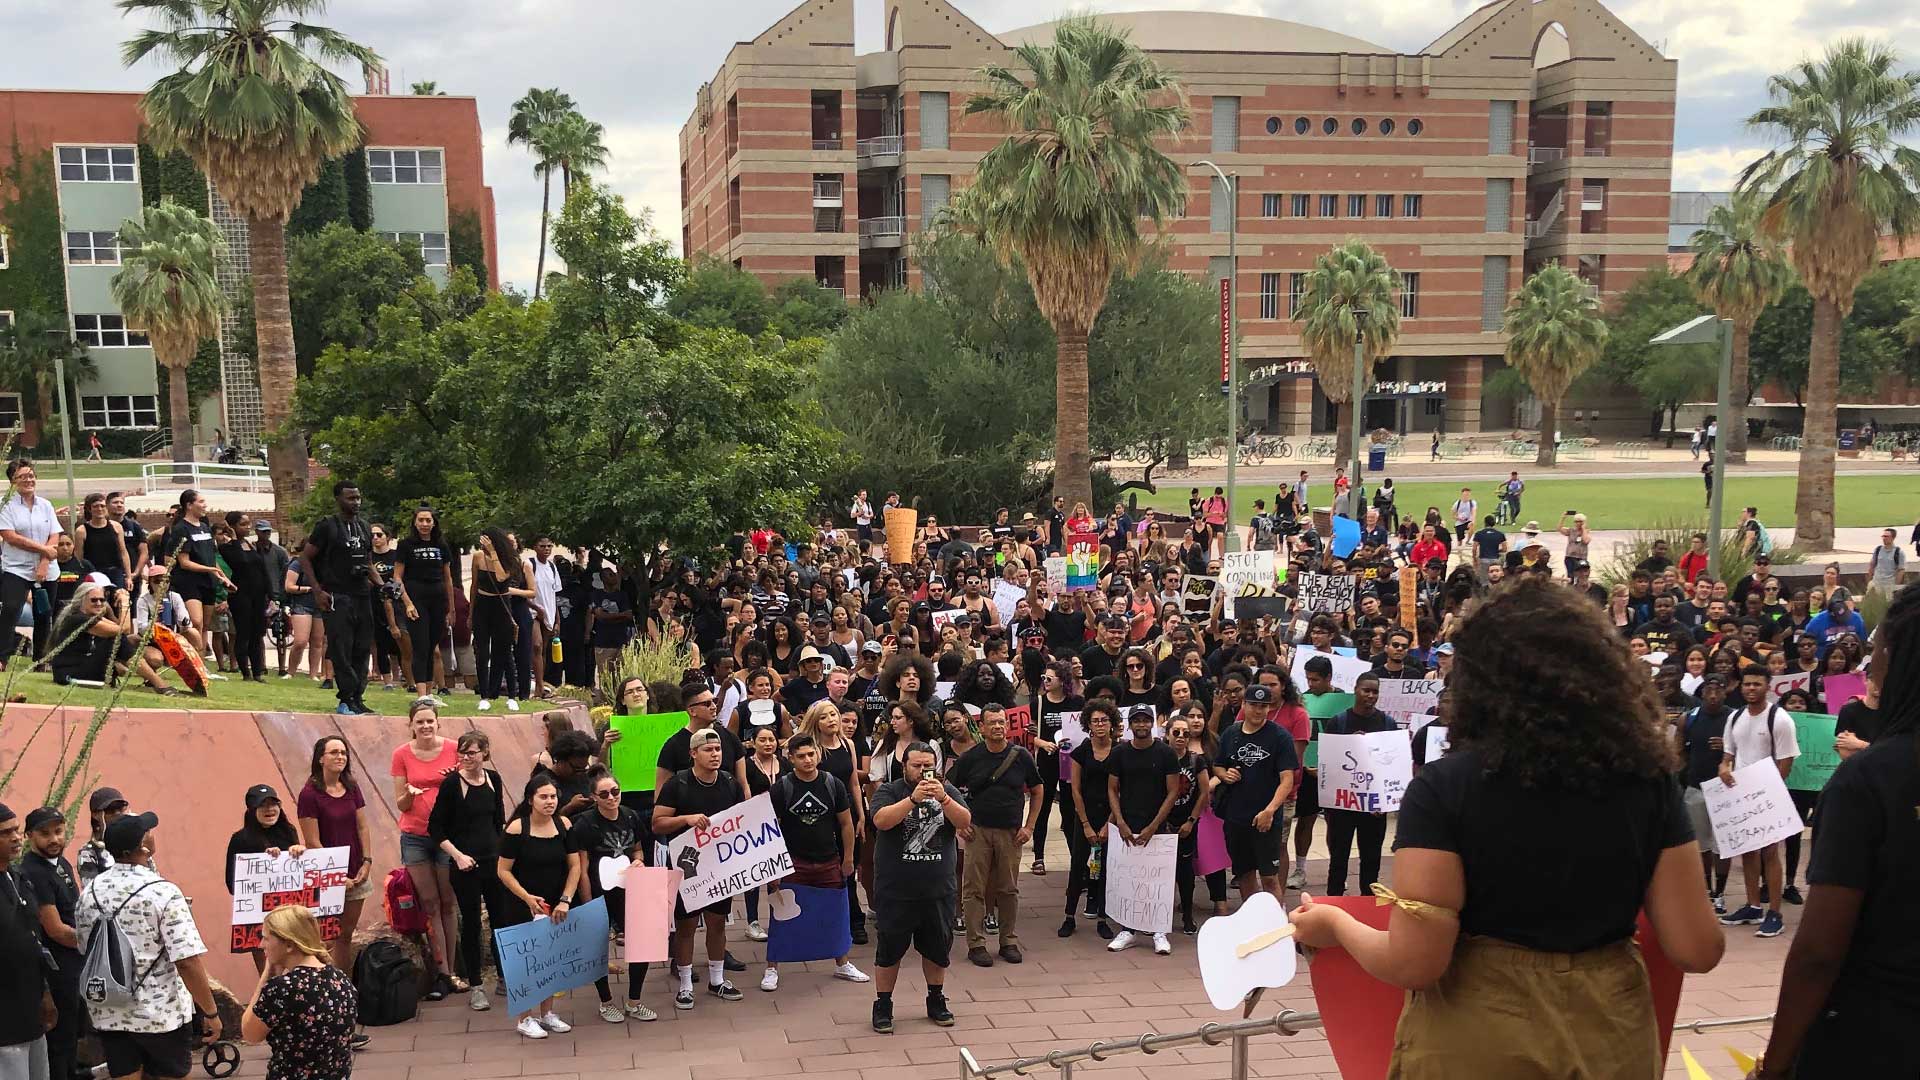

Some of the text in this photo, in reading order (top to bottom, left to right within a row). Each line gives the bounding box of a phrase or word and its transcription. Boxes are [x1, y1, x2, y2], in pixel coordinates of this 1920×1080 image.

[1227, 553, 1260, 568] STOP
[1299, 573, 1353, 588] THE REAL
[1298, 584, 1354, 599] EMERGENCY
[1402, 680, 1436, 695] BLACK
[1335, 788, 1382, 812] HATE
[694, 814, 744, 848] Bear
[716, 818, 781, 863] DOWN
[283, 857, 318, 874] COMES
[326, 855, 336, 870] A
[902, 853, 942, 861] ZAPATA
[234, 879, 263, 895] TIME
[268, 875, 301, 892] WHEN
[235, 899, 255, 912] IS
